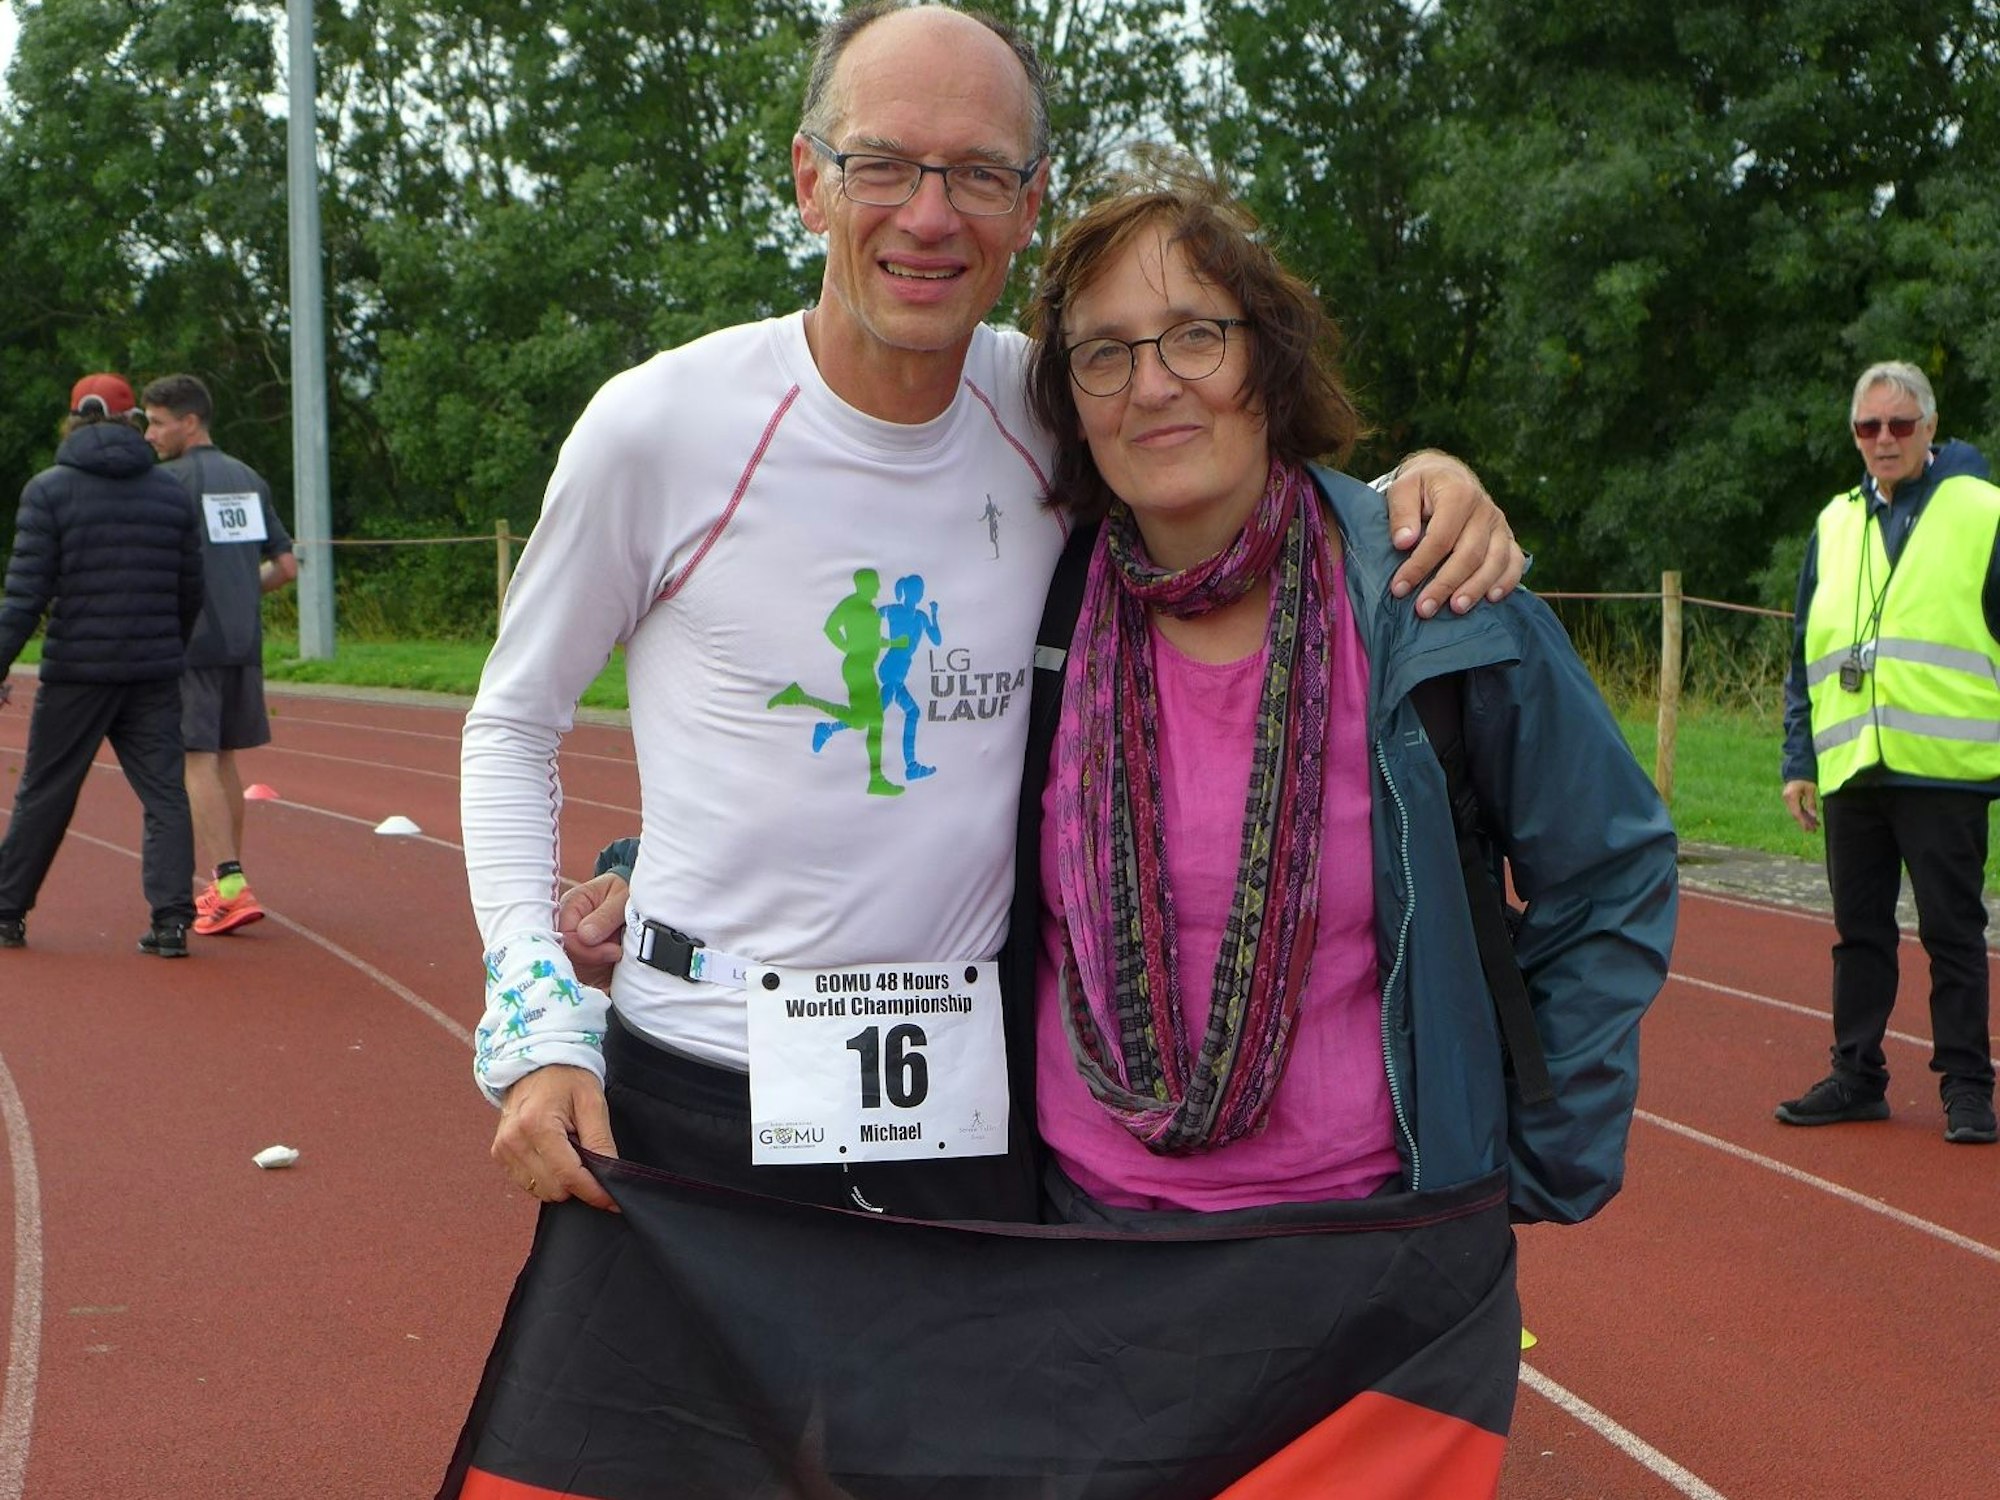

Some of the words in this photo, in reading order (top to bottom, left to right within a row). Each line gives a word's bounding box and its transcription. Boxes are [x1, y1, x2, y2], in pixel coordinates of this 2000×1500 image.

[218, 508, 247, 528] 130
[929, 648, 970, 672] LG
[931, 669, 1025, 697] ULTRA
[928, 695, 1011, 722] LAUF
[815, 974, 871, 993] GOMU
[876, 973, 898, 991] 48
[903, 972, 950, 991] Hours
[785, 997, 846, 1018] World
[851, 994, 972, 1016] Championship
[846, 1023, 928, 1109] 16
[860, 1122, 922, 1142] Michael
